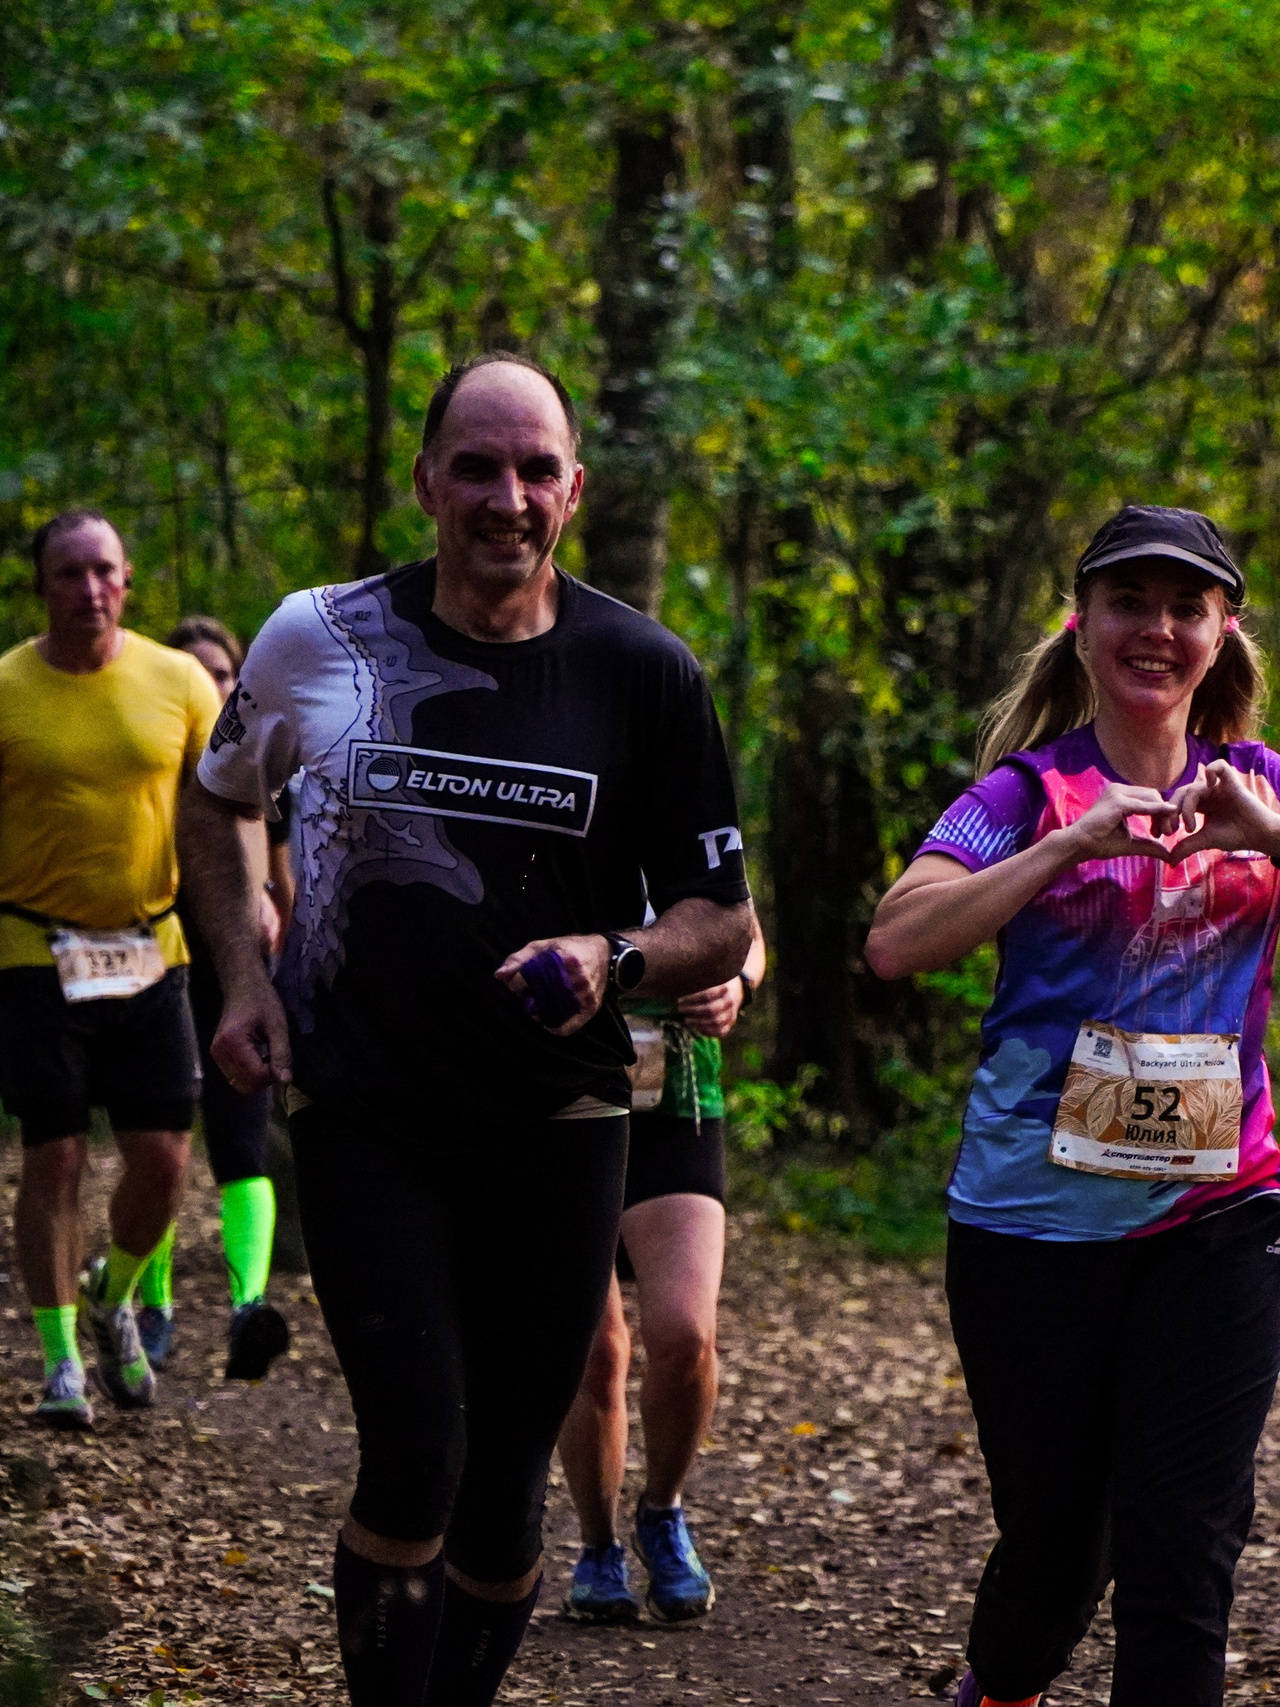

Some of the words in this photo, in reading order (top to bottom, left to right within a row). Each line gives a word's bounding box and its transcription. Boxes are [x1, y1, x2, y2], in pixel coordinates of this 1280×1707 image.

[406, 769, 493, 798] ELTON
[496, 781, 576, 812] ULTRA
[1140, 1060, 1177, 1069] Backyard
[1180, 1060, 1201, 1068] Ultra
[1131, 1086, 1181, 1122] 52
